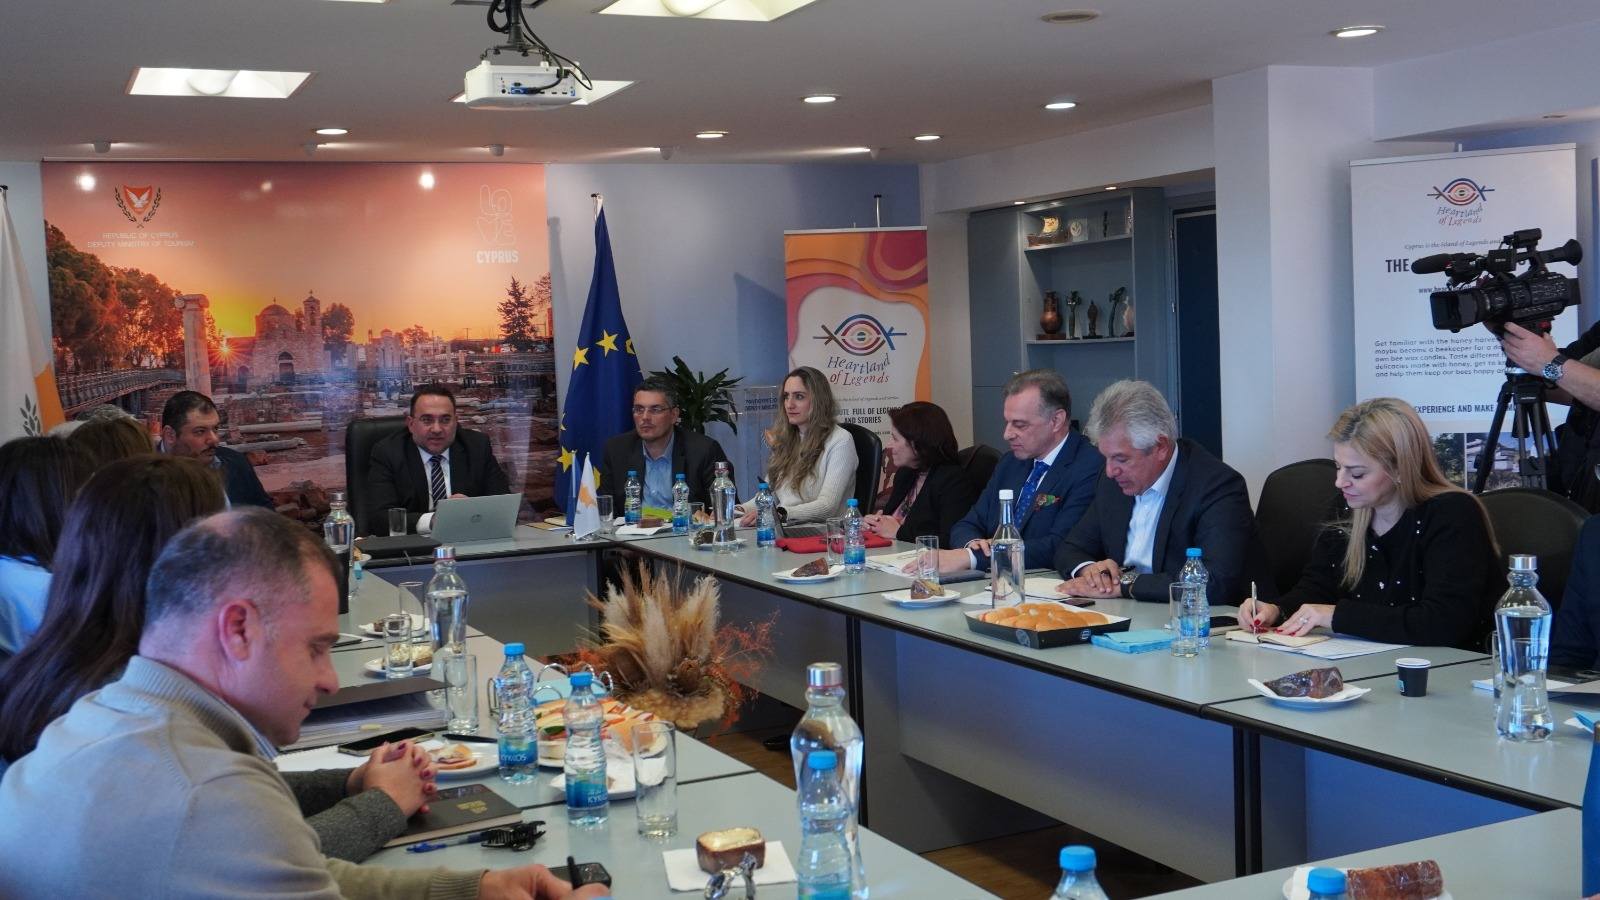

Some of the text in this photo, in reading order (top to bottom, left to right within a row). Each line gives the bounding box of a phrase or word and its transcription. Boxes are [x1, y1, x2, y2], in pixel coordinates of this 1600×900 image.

[1437, 203, 1483, 217] Heartland
[1439, 216, 1482, 226] of Legends
[477, 250, 519, 264] CYPRUS
[1385, 258, 1410, 272] THE
[828, 352, 890, 374] Heartland
[830, 370, 890, 386] of Legends
[1416, 404, 1494, 414] EXPERIENCE AND MAKE
